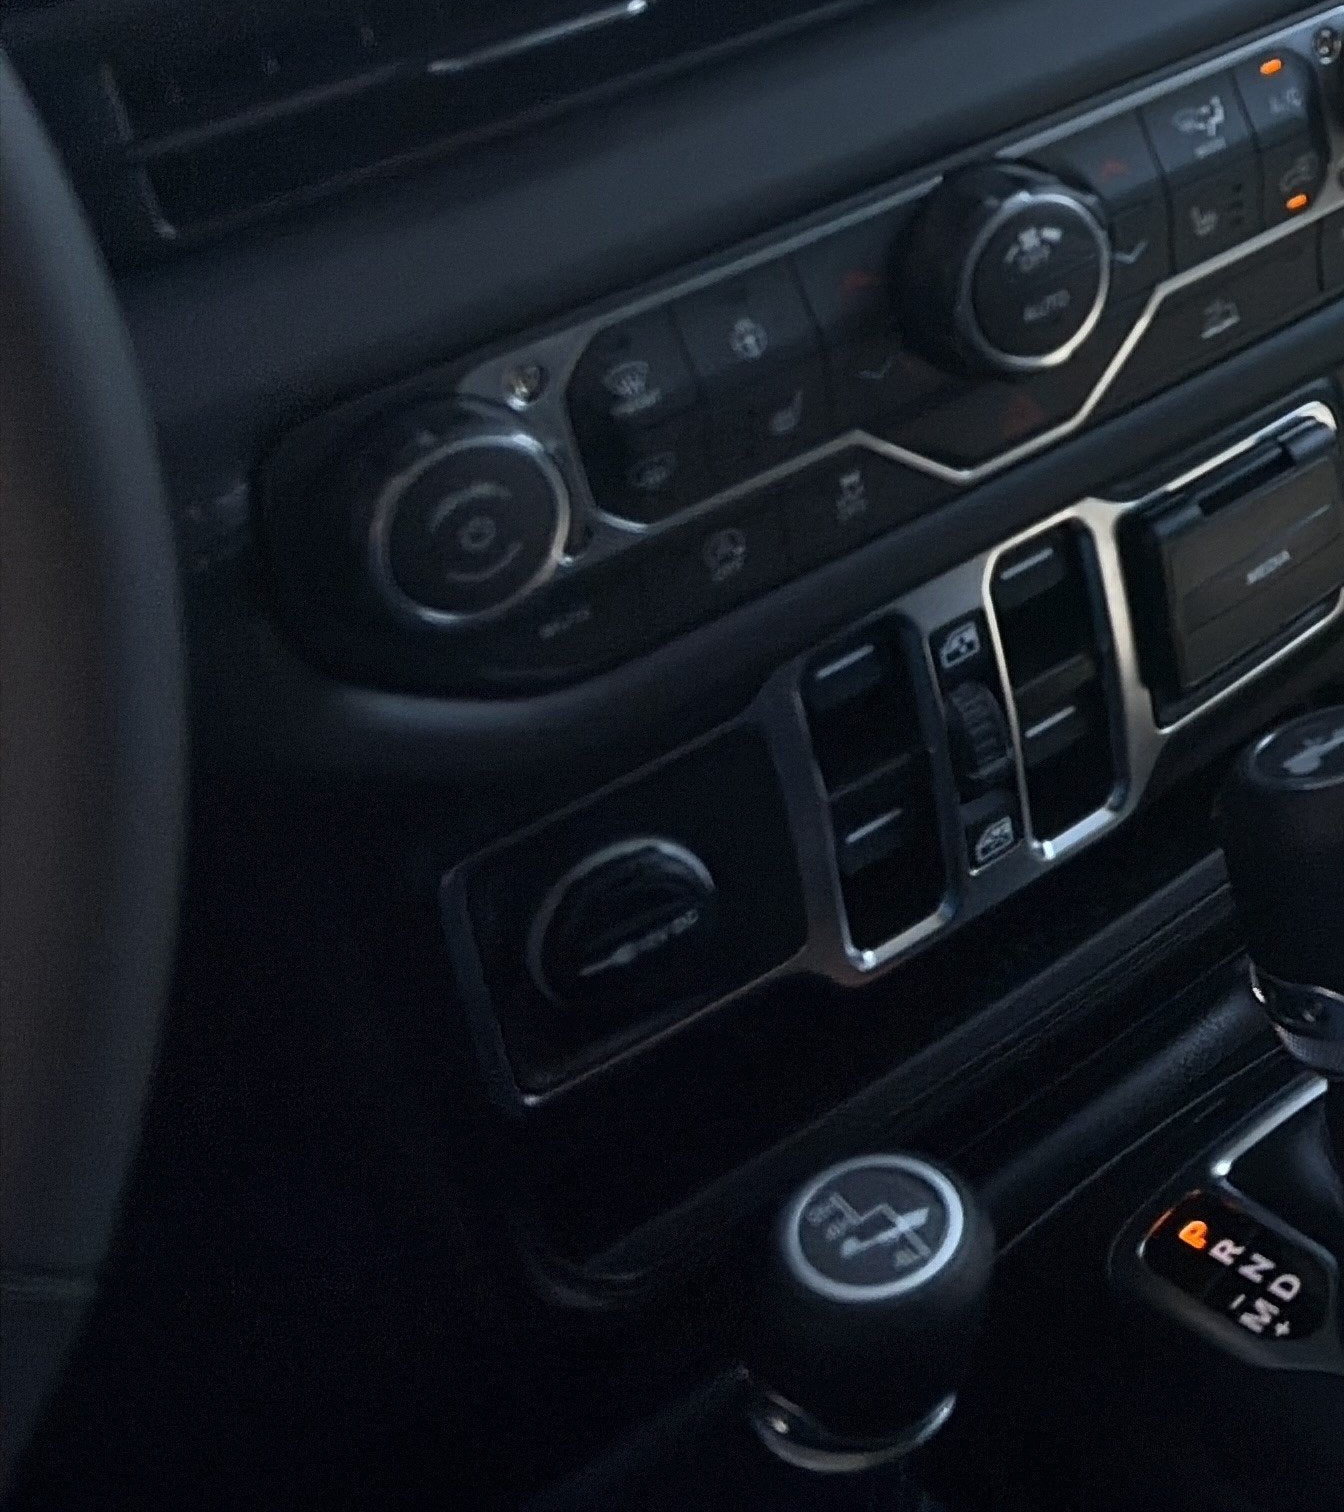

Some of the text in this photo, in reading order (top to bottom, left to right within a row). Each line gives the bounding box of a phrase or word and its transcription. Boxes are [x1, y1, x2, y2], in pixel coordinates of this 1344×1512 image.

[1178, 1220, 1208, 1249] P
[1208, 1239, 1246, 1266] R
[1238, 1252, 1277, 1284] N
[1267, 1273, 1302, 1303] D
